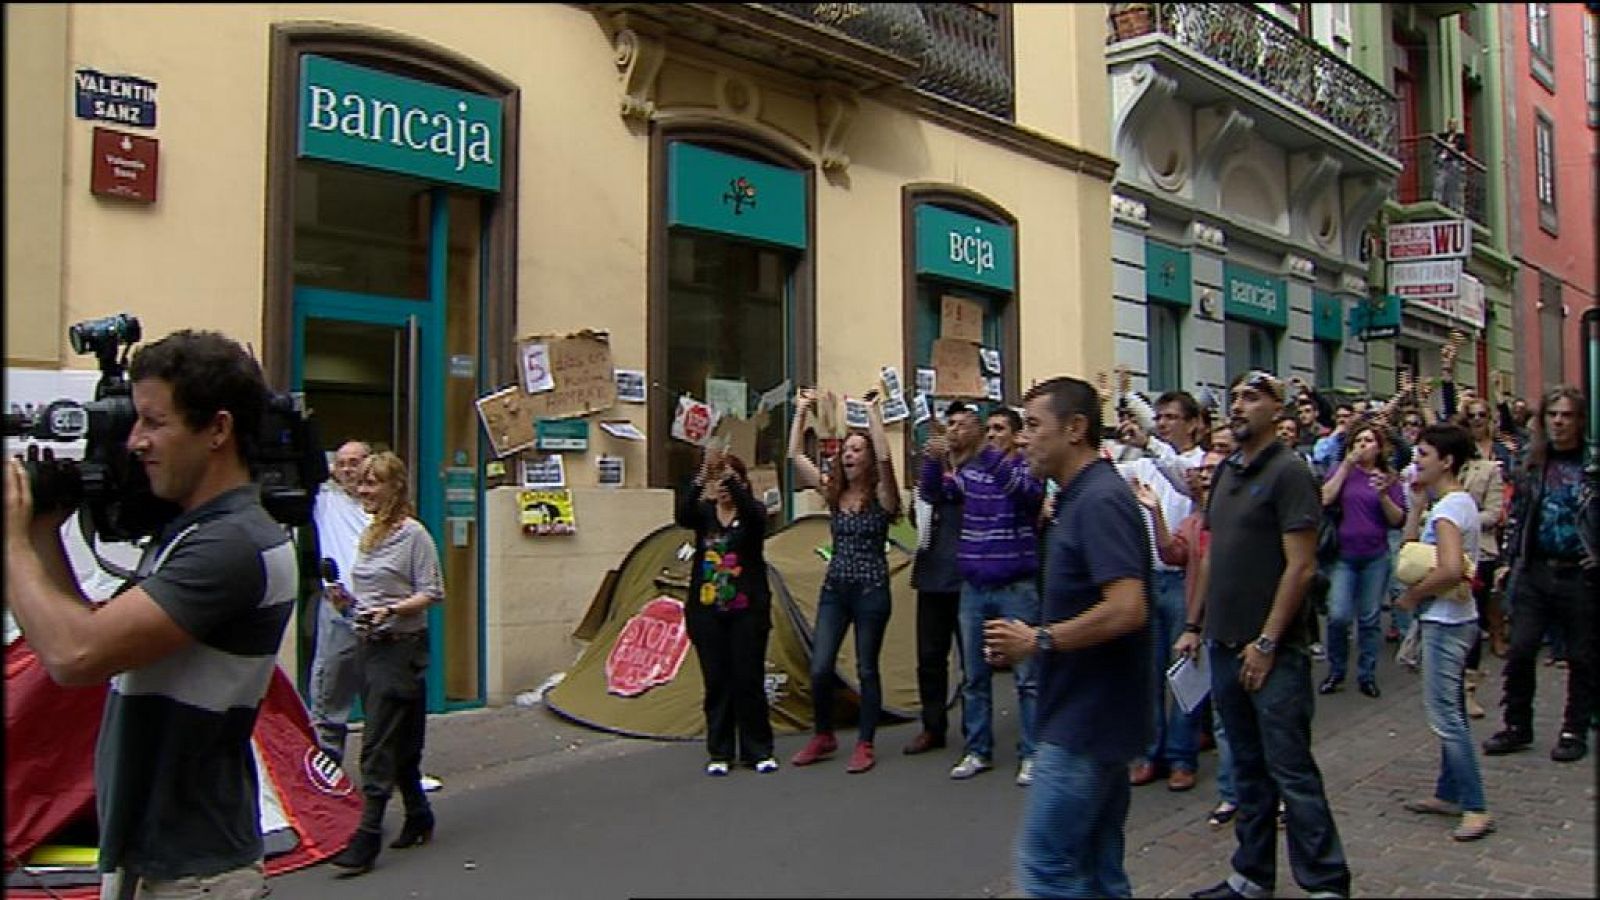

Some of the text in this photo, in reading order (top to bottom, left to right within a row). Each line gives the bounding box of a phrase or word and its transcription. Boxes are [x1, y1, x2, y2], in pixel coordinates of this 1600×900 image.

[75, 72, 157, 102] VALENTIN
[93, 100, 141, 124] SANZ
[307, 84, 494, 171] Bancaja
[1432, 223, 1464, 253] WU
[526, 351, 546, 384] 5
[621, 616, 682, 653] STOP
